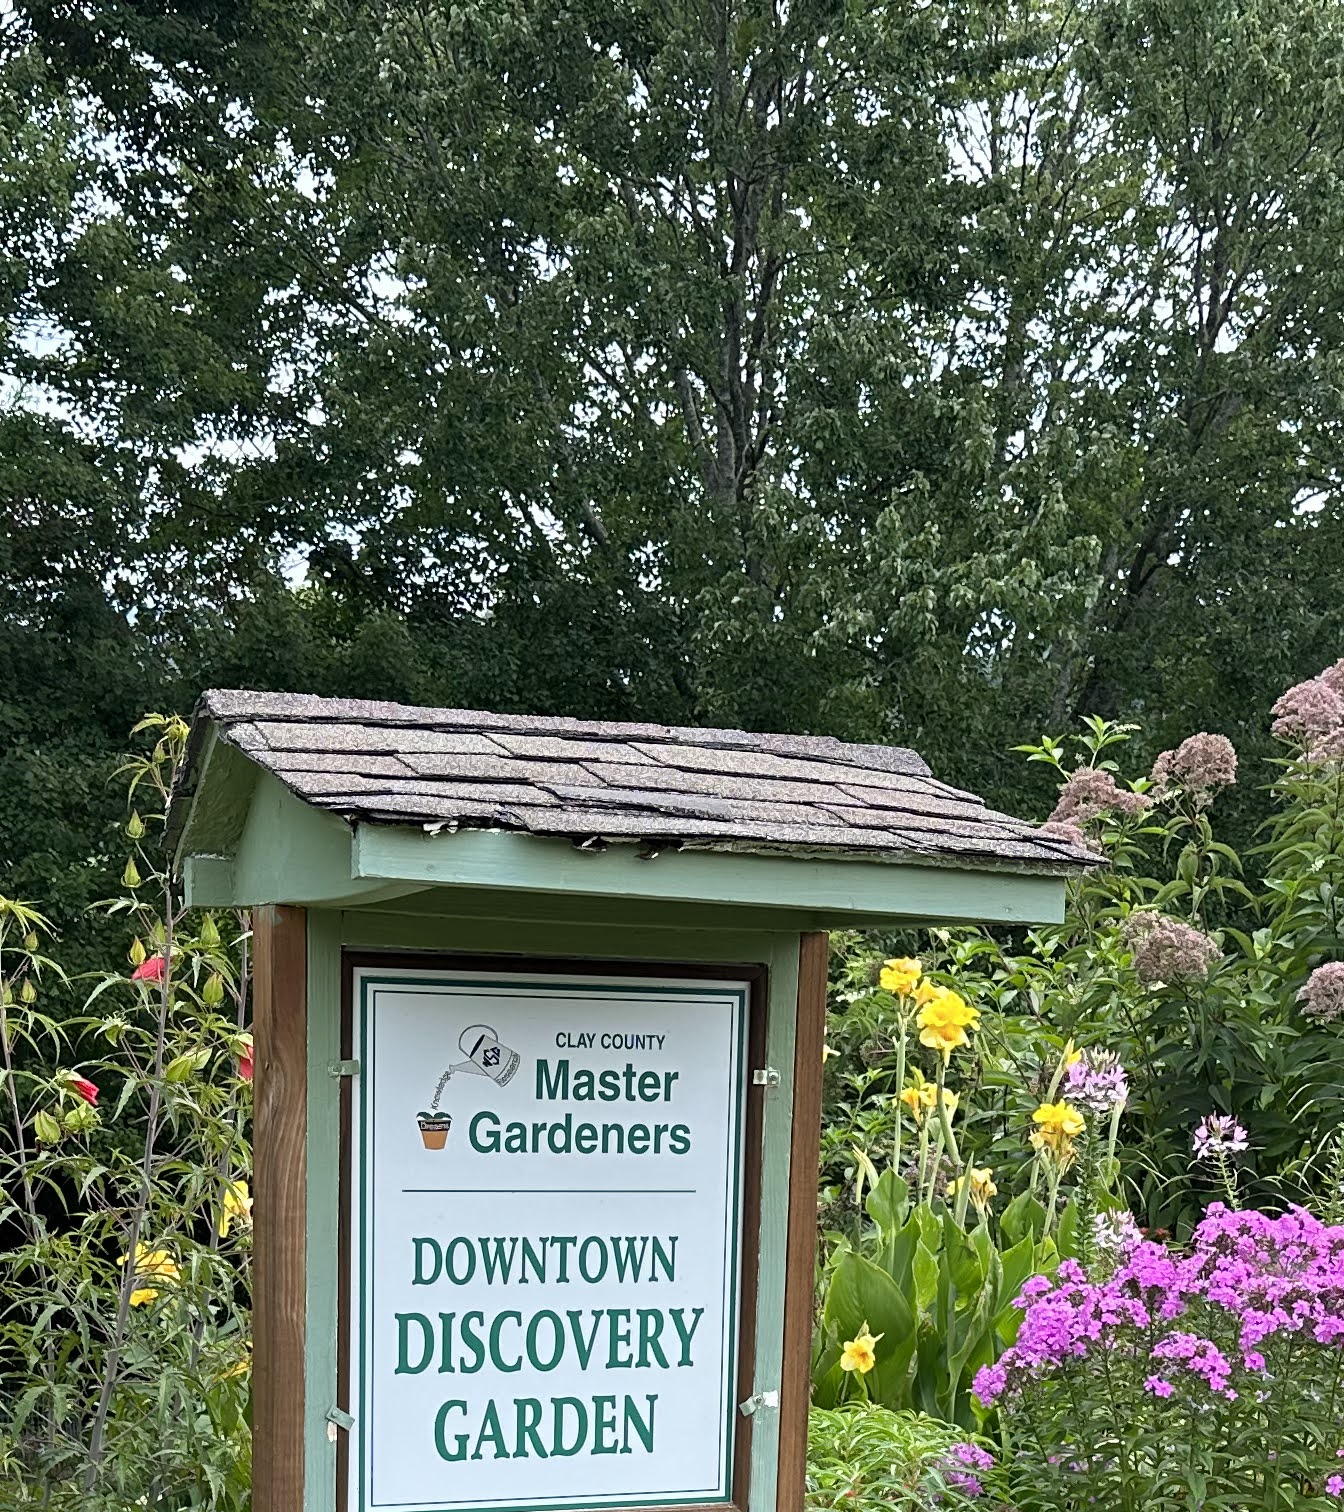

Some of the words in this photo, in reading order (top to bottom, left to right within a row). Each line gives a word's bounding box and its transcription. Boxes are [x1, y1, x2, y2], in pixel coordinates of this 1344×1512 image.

[556, 1032, 596, 1048] CLAY
[601, 1034, 665, 1050] COUNTY
[536, 1059, 679, 1102] Master
[469, 1111, 690, 1154] Gardeners
[412, 1236, 678, 1285] DOWNTOWN
[395, 1308, 704, 1375] DISCOVERY
[435, 1394, 658, 1461] GARDEN
